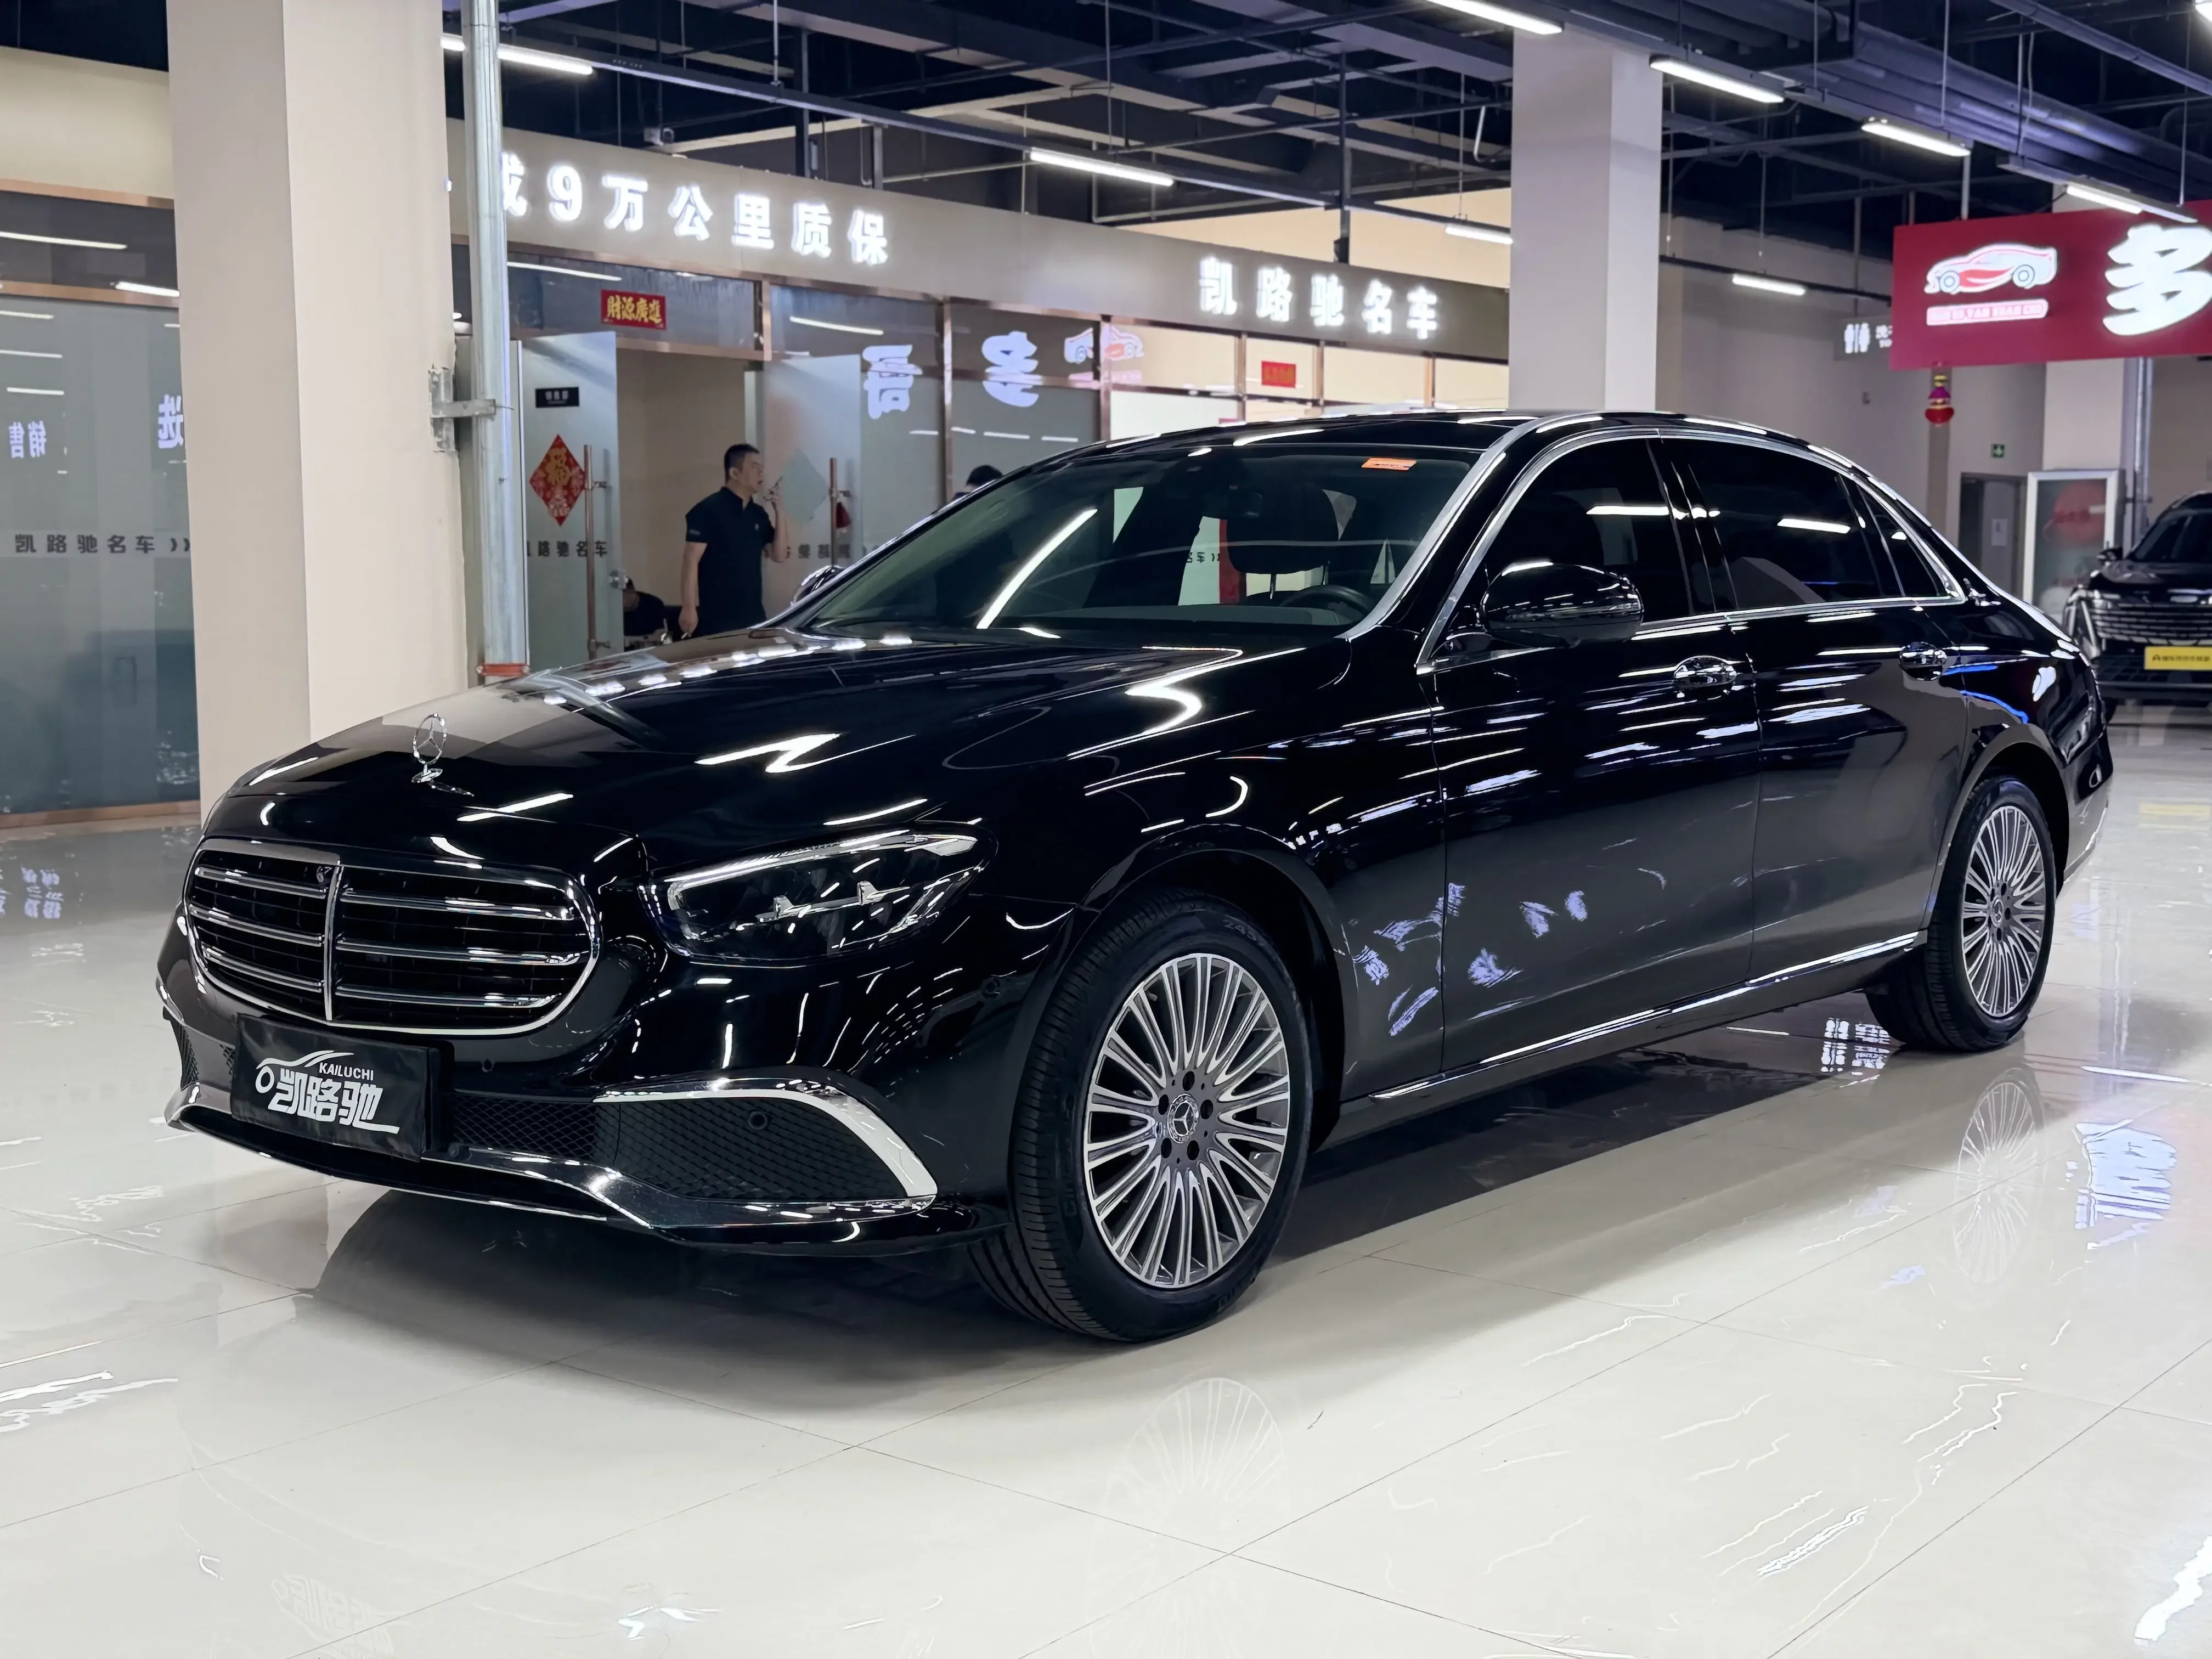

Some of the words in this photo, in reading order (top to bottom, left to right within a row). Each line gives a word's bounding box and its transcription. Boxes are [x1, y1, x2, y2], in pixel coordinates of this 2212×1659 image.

[1199, 256, 1438, 340] 凯路驰名车
[2102, 222, 2212, 336] 多
[14, 534, 155, 554] 凯路驰名车
[527, 540, 607, 558] 路驰名车
[319, 1062, 374, 1081] KAILUCHI
[267, 1067, 400, 1135] 凯路驰
